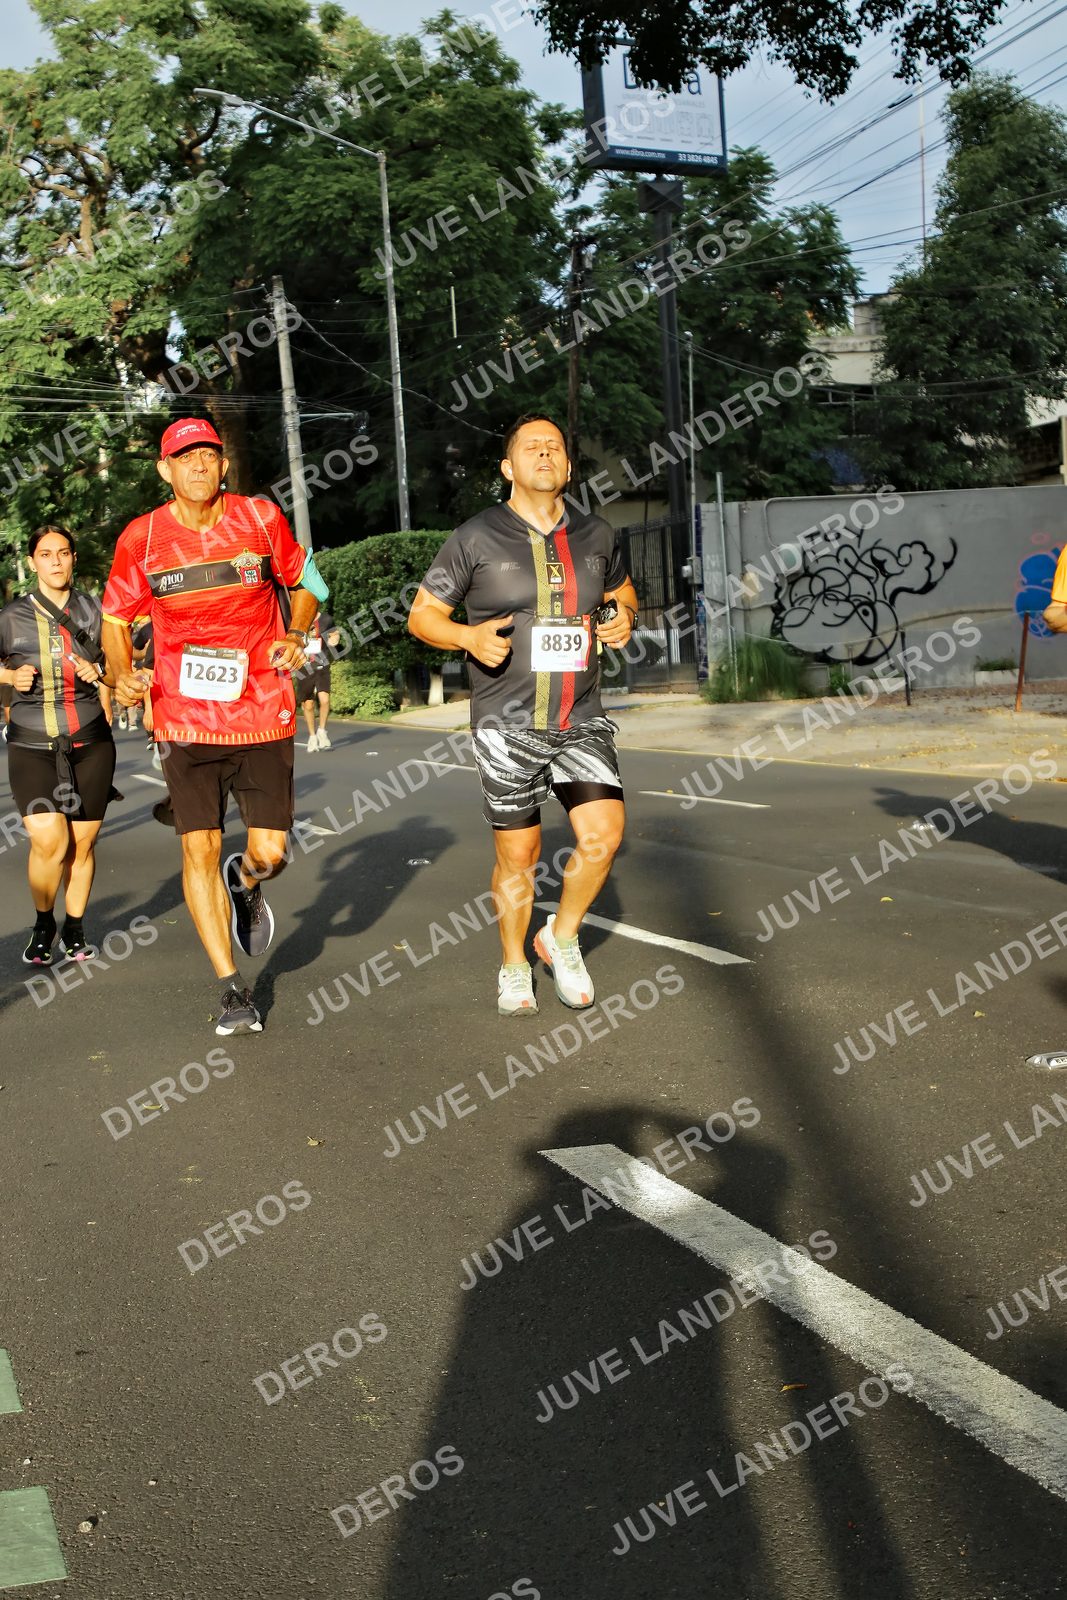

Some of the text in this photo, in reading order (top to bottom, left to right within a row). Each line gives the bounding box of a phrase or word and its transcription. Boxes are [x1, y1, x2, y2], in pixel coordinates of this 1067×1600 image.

[167, 572, 184, 585] 100
[541, 634, 582, 651] 8839
[185, 662, 238, 683] 12623
